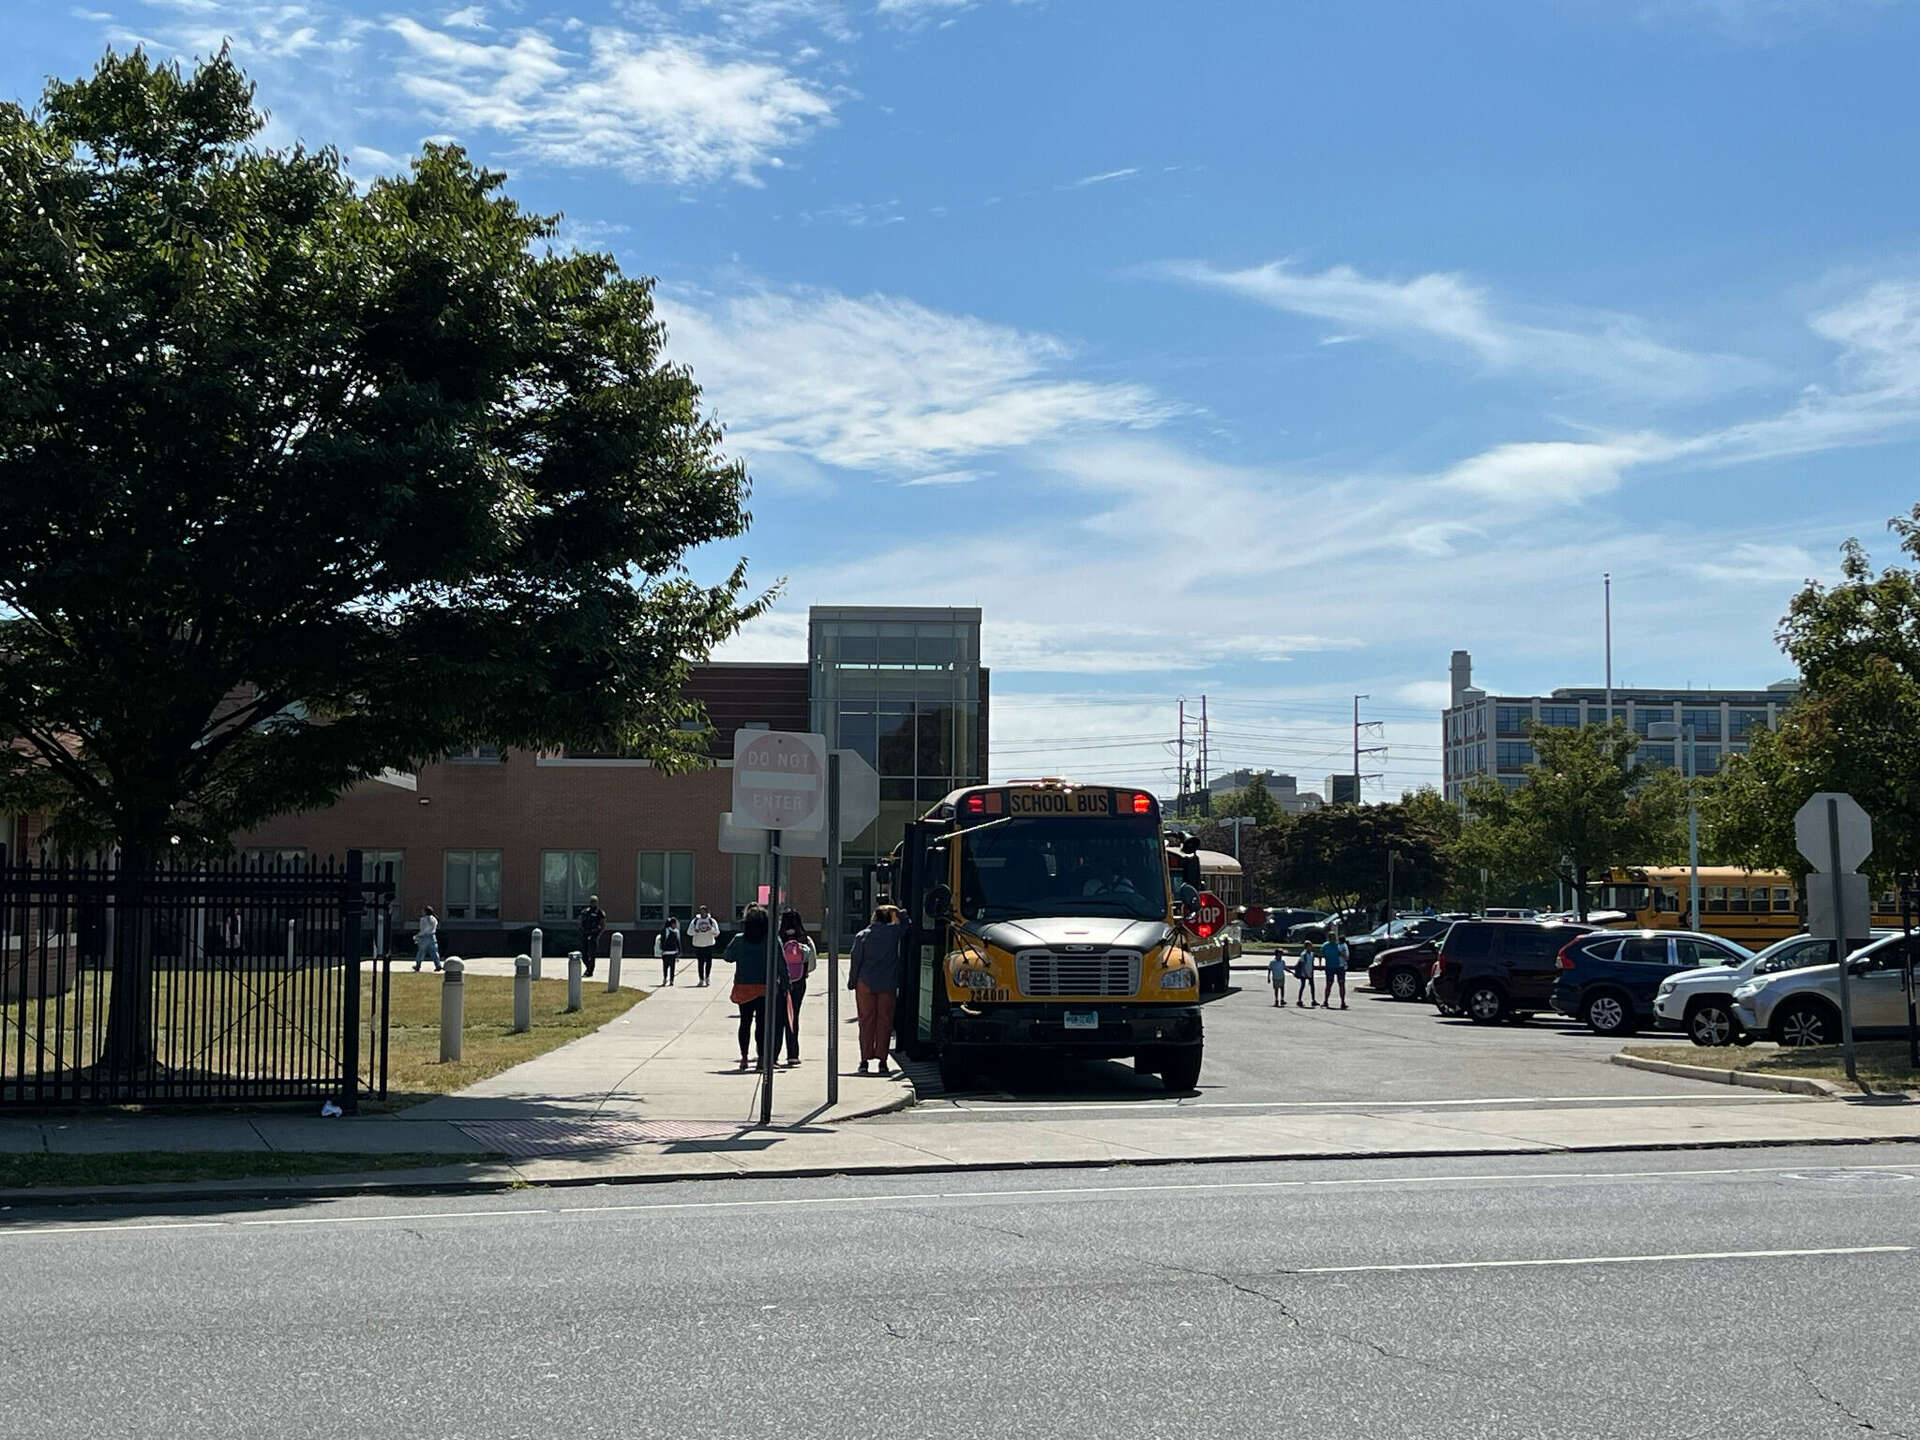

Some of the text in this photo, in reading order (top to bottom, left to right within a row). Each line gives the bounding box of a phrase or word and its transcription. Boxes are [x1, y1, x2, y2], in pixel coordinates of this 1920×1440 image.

[748, 751, 810, 768] DO NOT
[753, 793, 803, 811] ENTER
[1011, 794, 1107, 812] SCHOOL BUS
[1187, 907, 1220, 924] TOP
